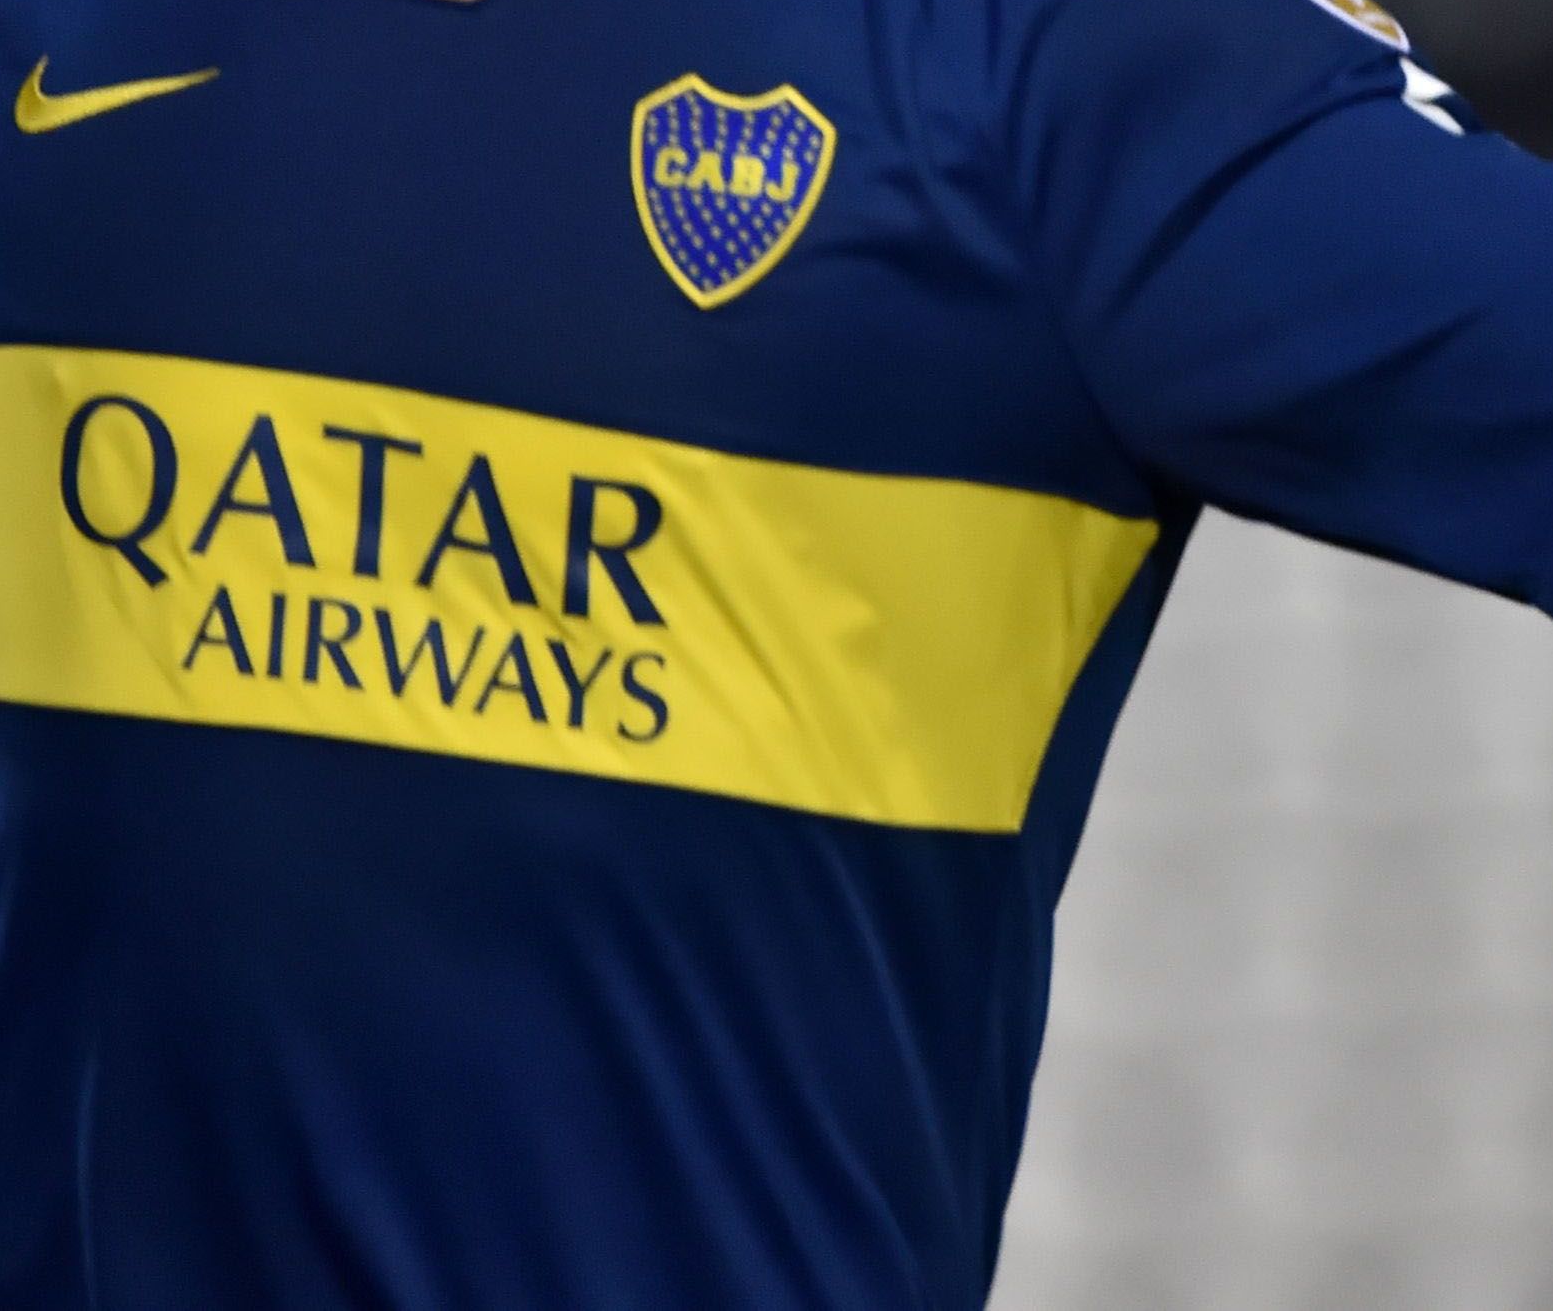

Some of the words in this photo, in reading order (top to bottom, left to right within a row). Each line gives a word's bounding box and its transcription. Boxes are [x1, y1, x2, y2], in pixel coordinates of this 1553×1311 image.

[654, 145, 799, 202] CABJ
[59, 393, 667, 628] QATAR
[183, 585, 669, 741] AIRWAYS
